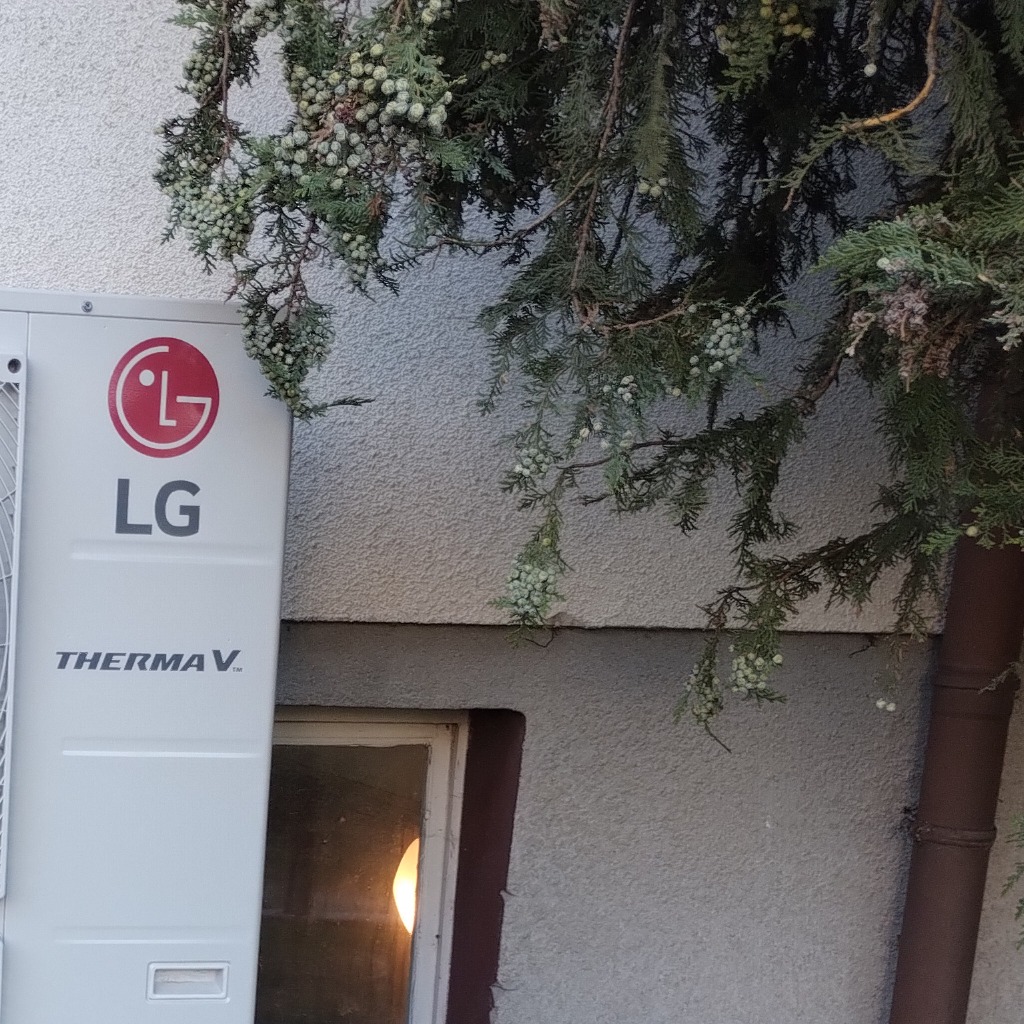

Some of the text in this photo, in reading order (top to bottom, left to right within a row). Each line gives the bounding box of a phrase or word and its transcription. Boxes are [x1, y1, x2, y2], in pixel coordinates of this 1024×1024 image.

[116, 346, 212, 450] LG
[115, 478, 201, 537] LG
[56, 651, 205, 672] THERMA
